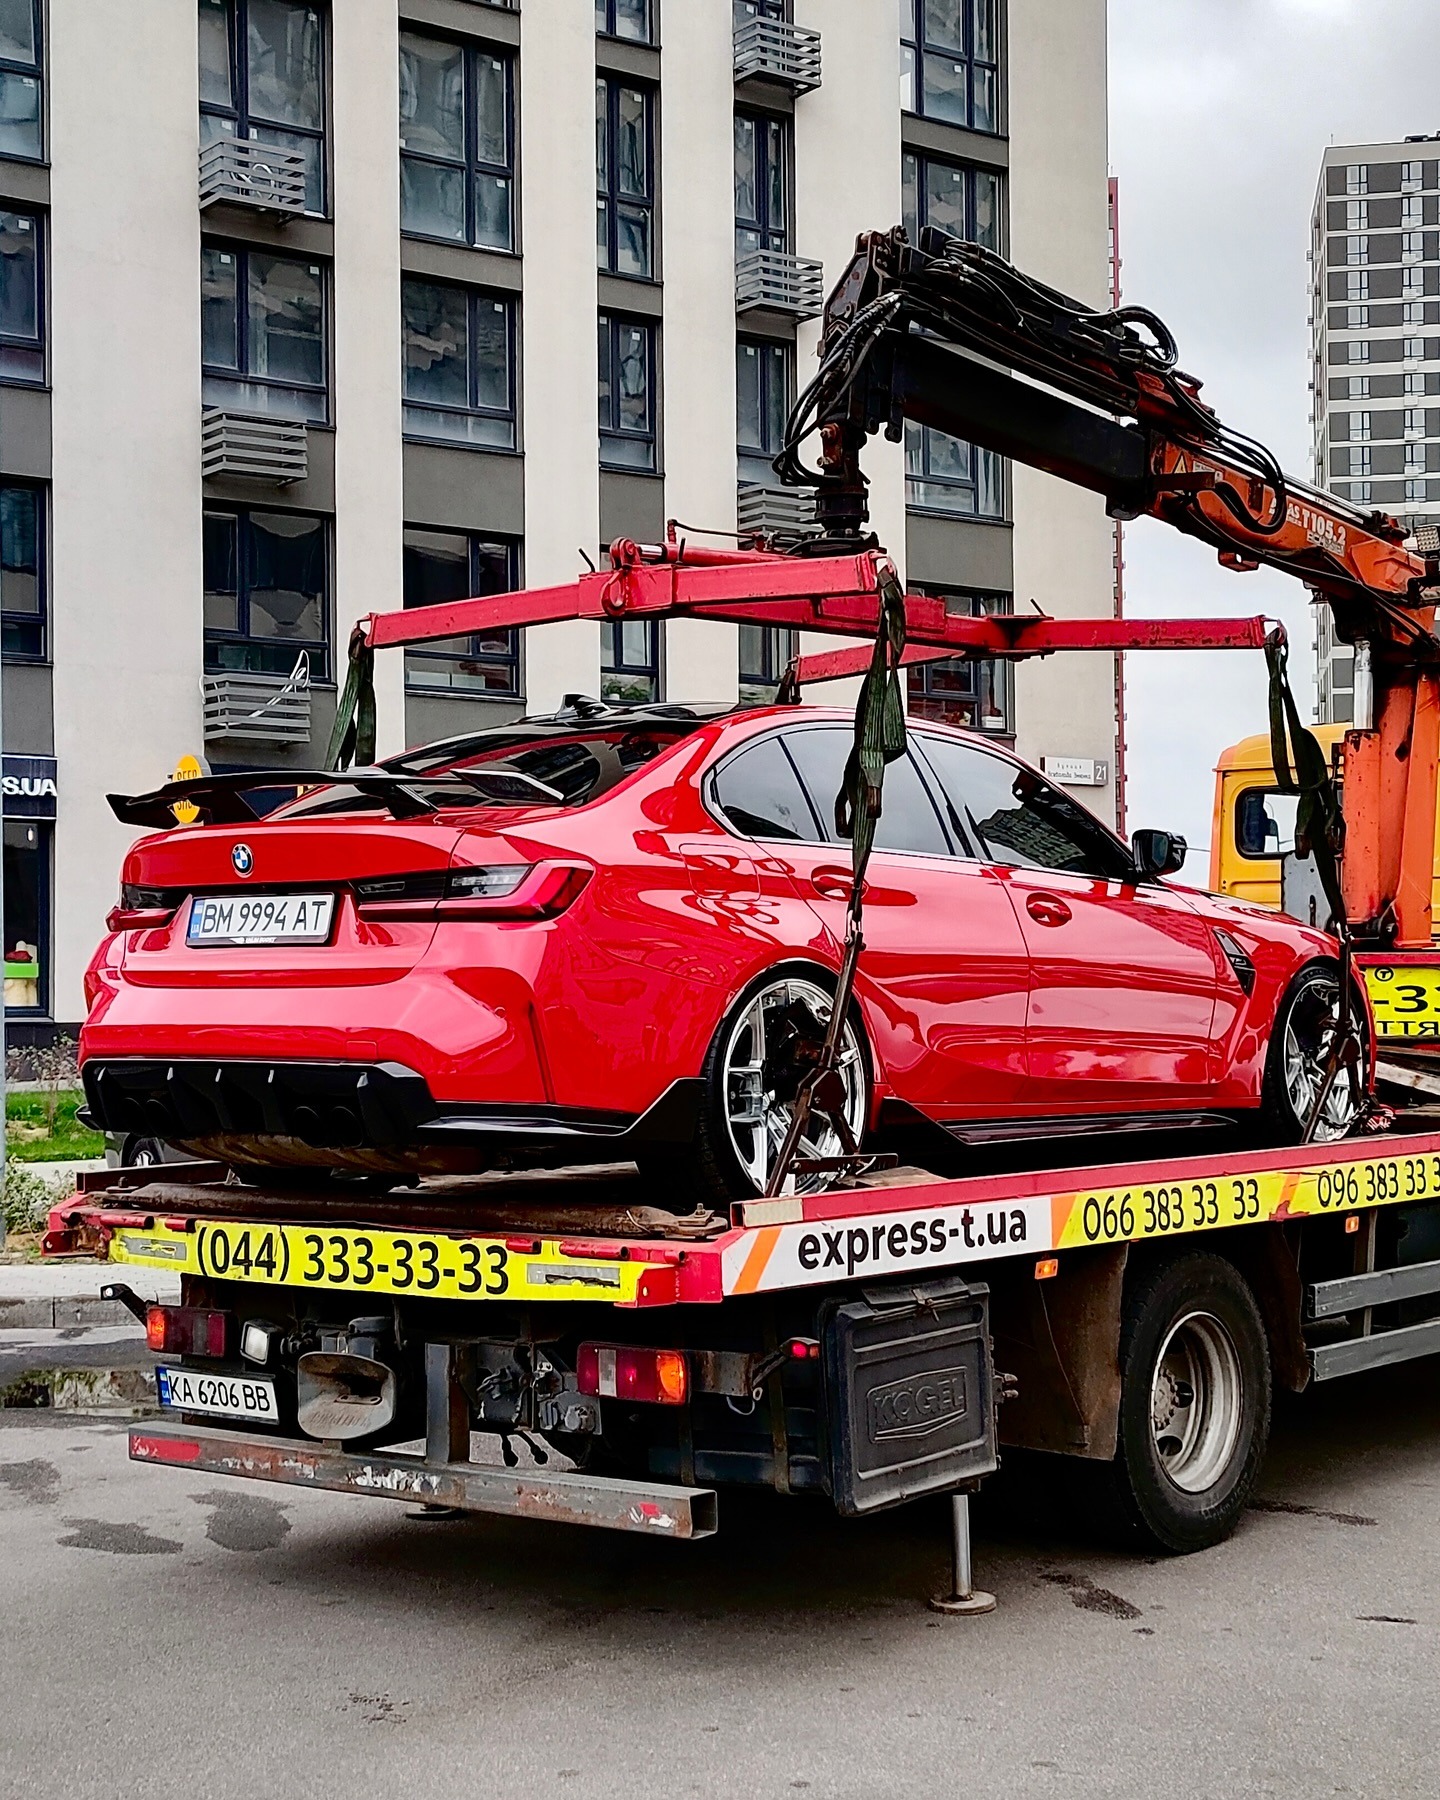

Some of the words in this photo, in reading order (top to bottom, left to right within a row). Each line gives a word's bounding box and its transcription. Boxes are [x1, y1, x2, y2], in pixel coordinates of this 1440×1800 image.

[1, 776, 58, 797] S.UA
[1095, 765, 1107, 780] 21
[201, 903, 234, 933] BM
[237, 901, 288, 932] 9994
[292, 900, 327, 931] AT
[1373, 985, 1440, 1013] -3
[1318, 1166, 1358, 1208] 096
[1365, 1162, 1399, 1201] 383
[1405, 1158, 1426, 1196] 33
[1083, 1192, 1135, 1241] 066
[1143, 1187, 1184, 1233] 383
[1192, 1183, 1219, 1226] 33
[1232, 1178, 1260, 1220] 33
[197, 1226, 290, 1282] (044)
[303, 1234, 509, 1294] 333-33-33
[798, 1208, 1027, 1276] express-t.ua
[168, 1375, 195, 1403] KA
[198, 1379, 240, 1408] 6206
[241, 1384, 271, 1412] BB
